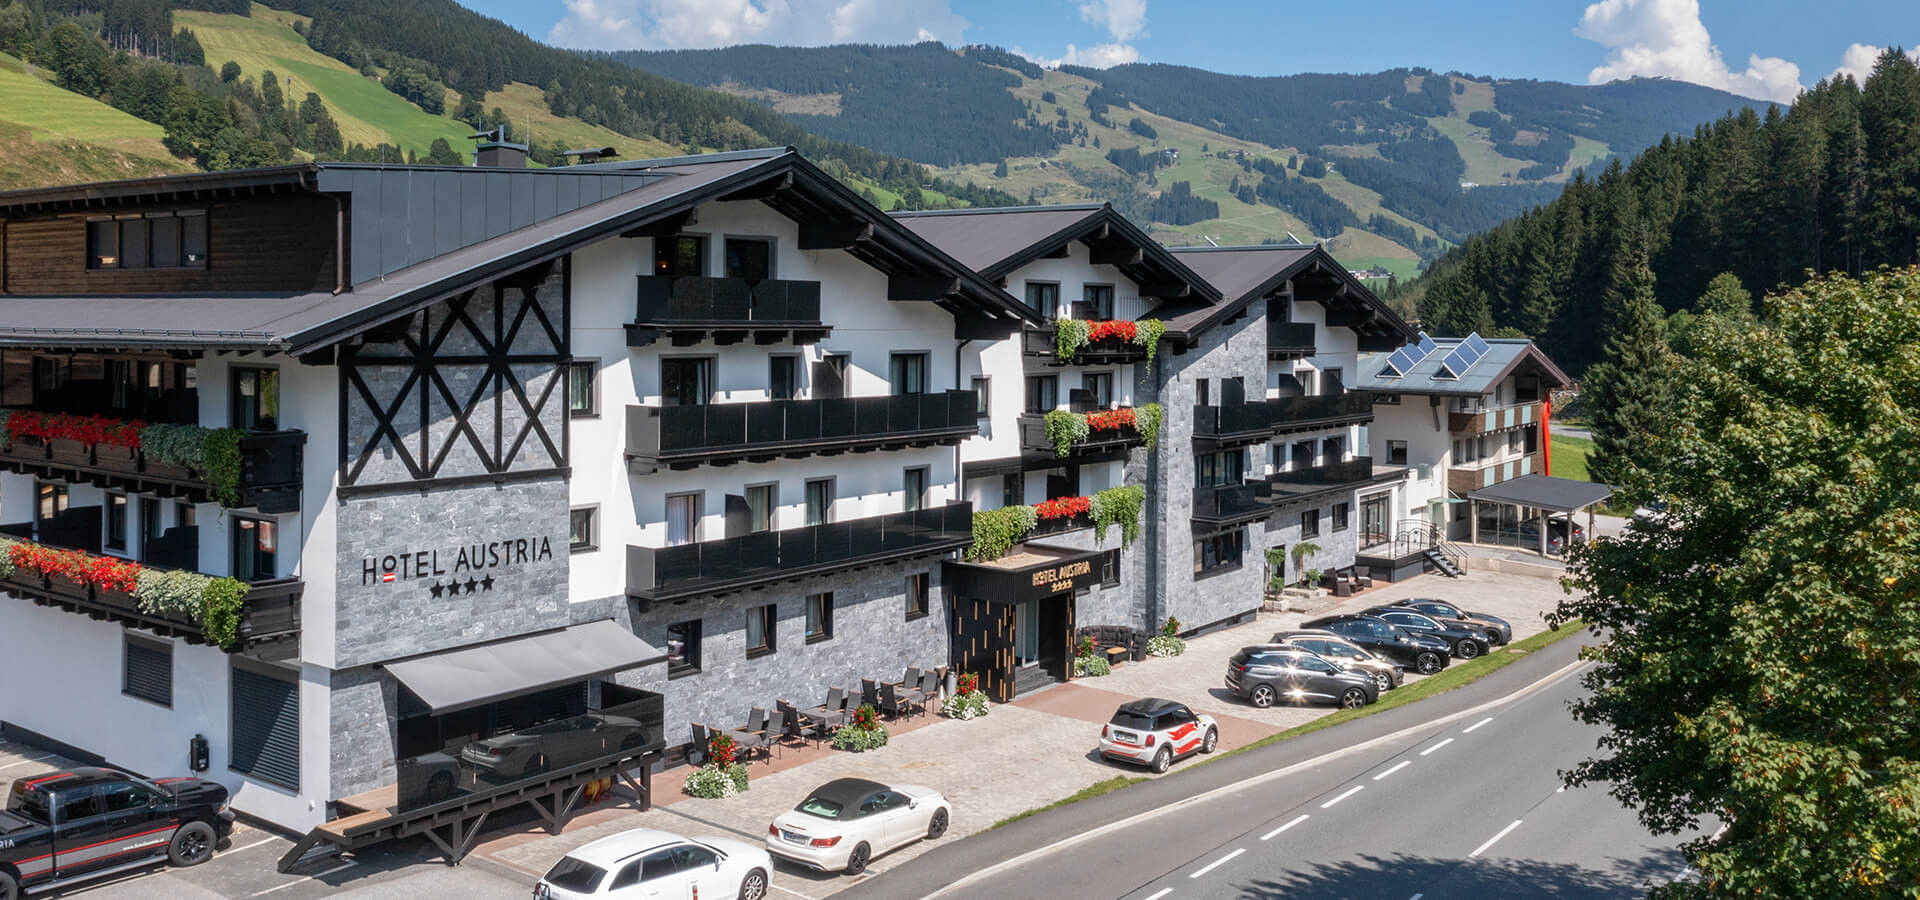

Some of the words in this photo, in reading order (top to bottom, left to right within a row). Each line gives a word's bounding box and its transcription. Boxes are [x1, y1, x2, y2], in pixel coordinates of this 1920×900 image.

[362, 550, 445, 586] HOTEL
[455, 536, 552, 572] AUSTRIA
[1032, 569, 1058, 586] HOTEL
[1059, 561, 1091, 580] AUSTRIA
